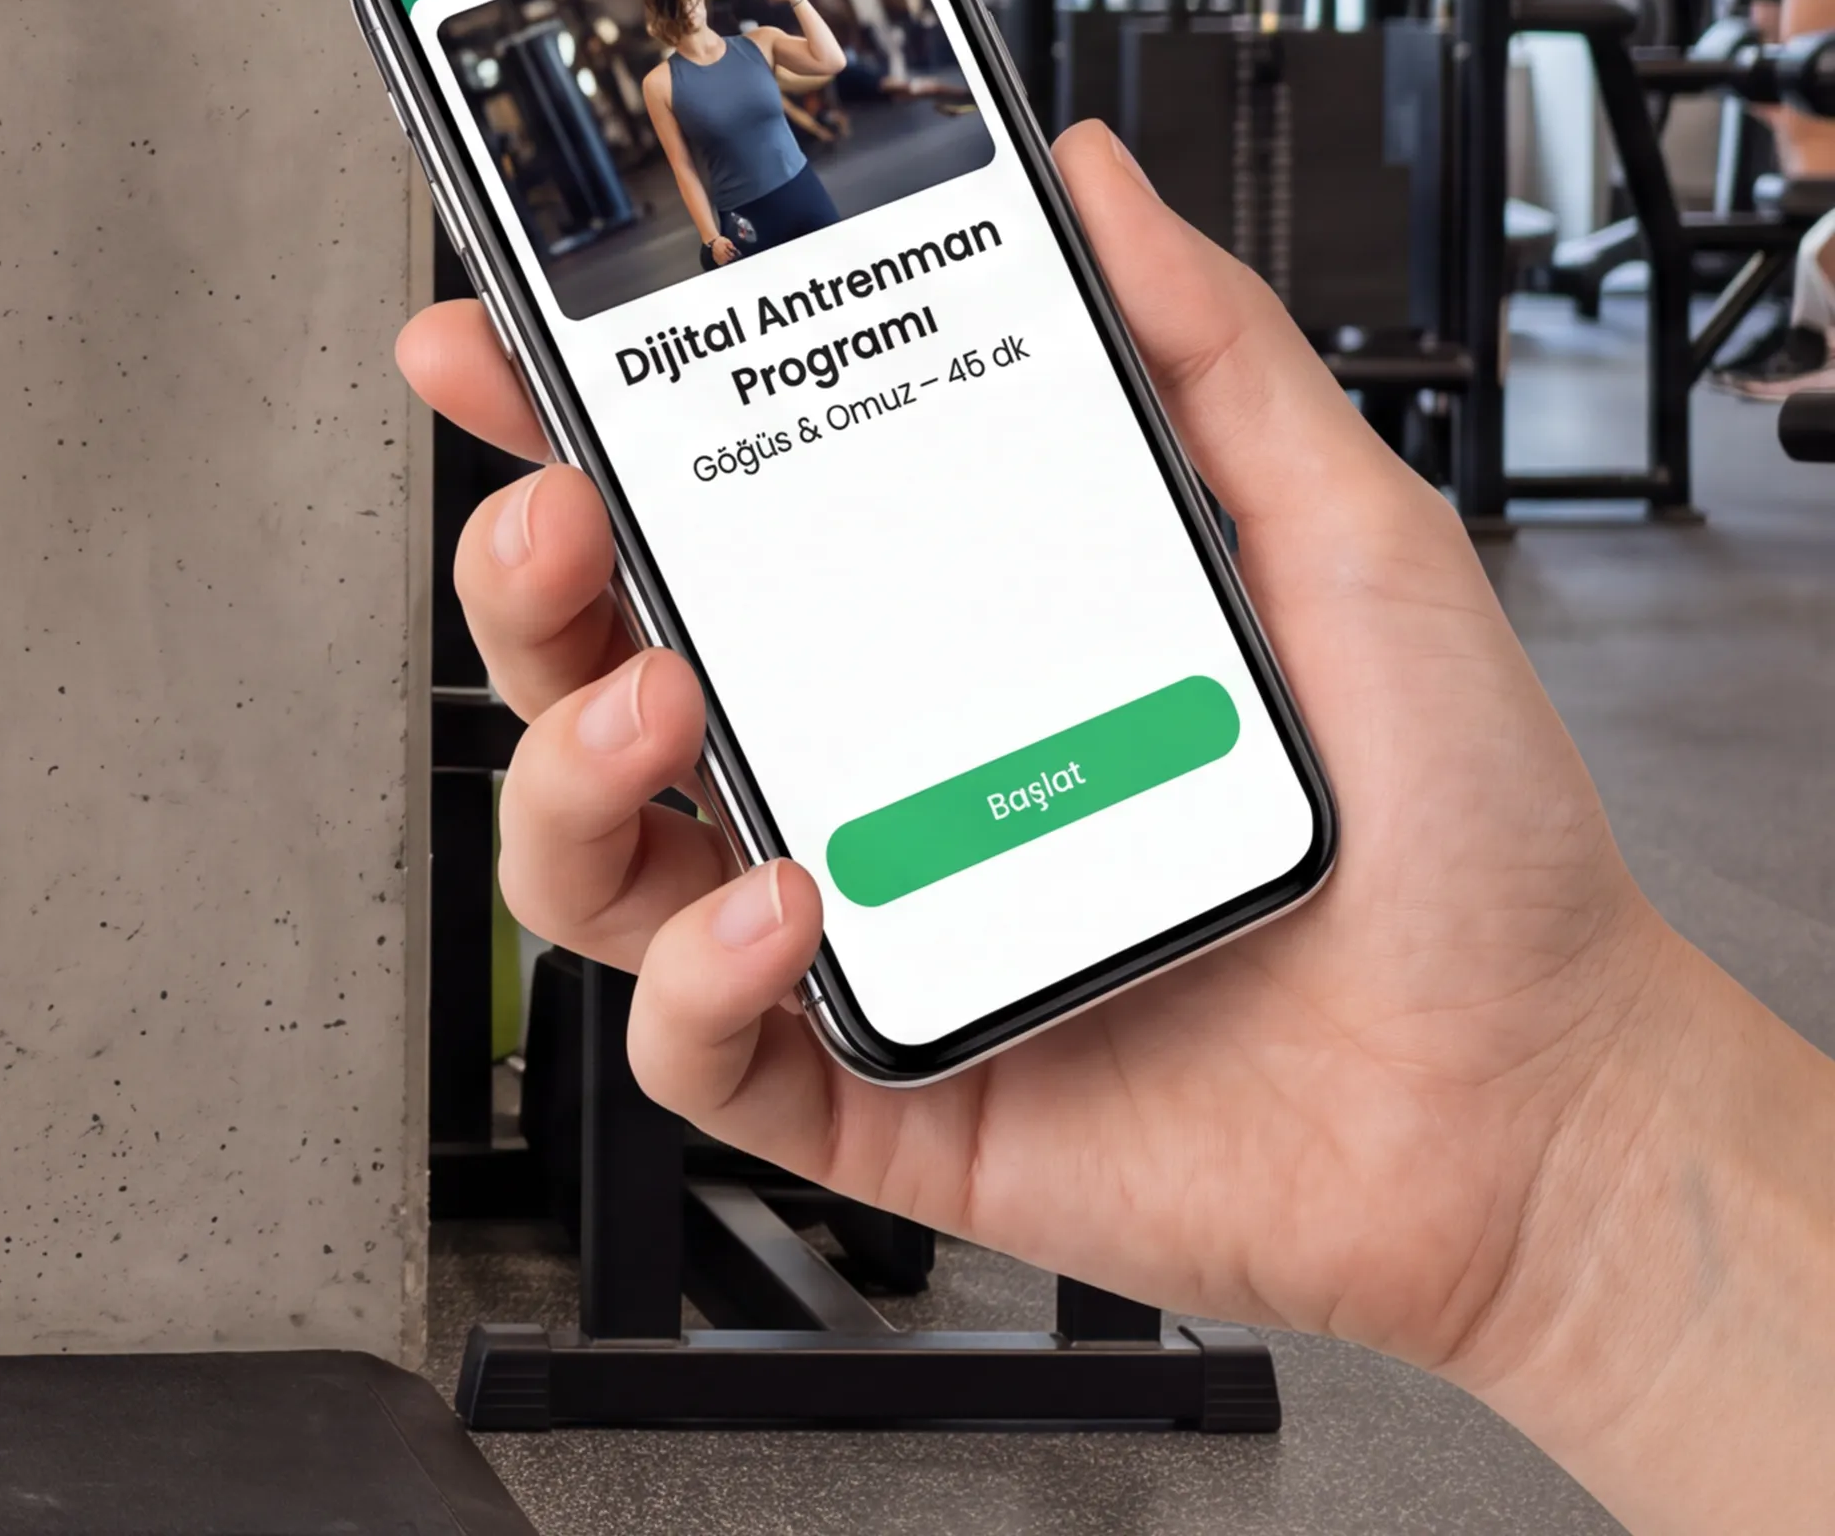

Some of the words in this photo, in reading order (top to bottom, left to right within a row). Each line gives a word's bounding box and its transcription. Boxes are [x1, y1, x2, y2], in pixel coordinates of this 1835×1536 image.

[615, 307, 747, 386] Dijital
[758, 220, 1003, 335] Antrenman
[731, 306, 939, 405] Programı
[798, 417, 822, 443] &
[826, 382, 917, 431] Omuz
[992, 335, 1031, 367] dk
[986, 761, 1087, 821] Başlat
